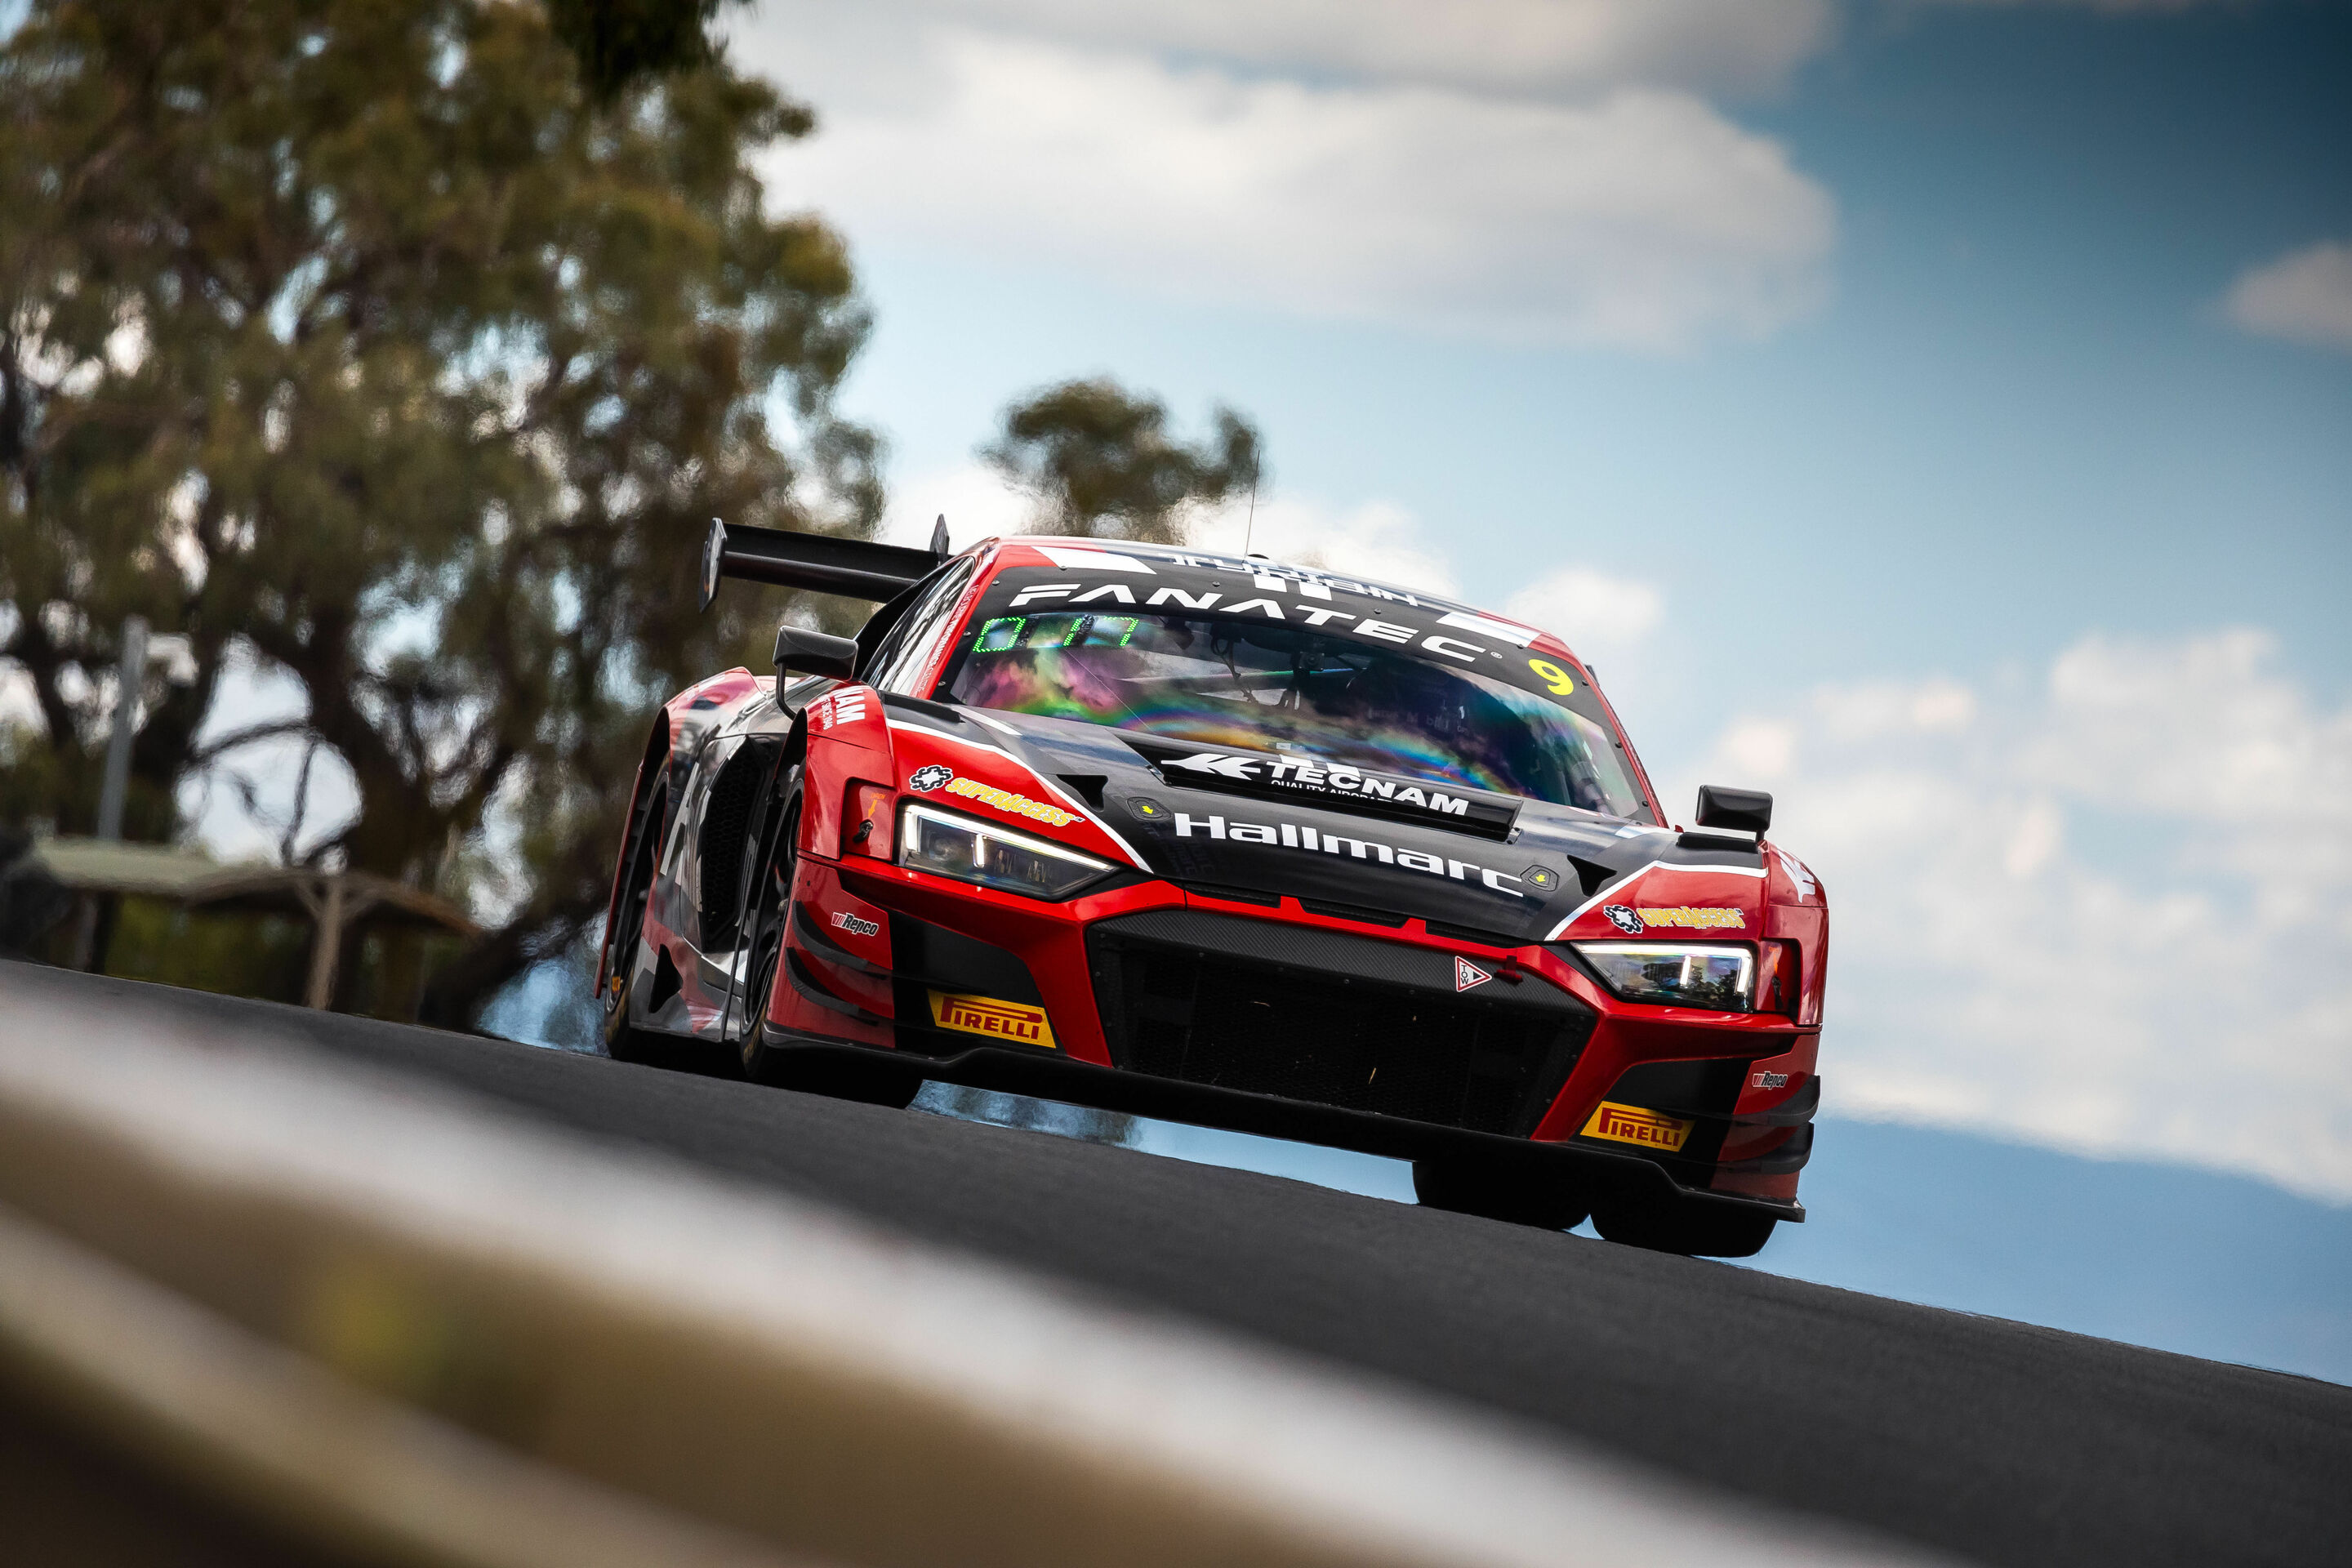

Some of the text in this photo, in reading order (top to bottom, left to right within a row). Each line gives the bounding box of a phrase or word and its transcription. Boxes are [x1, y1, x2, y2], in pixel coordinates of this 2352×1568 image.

[1008, 583, 1486, 662] FANATEC
[1528, 658, 1575, 696] 9
[1266, 760, 1468, 815] TECNAM
[1174, 812, 1525, 897] Hallmarc
[841, 912, 879, 936] Repco
[1460, 964, 1469, 985] TOW
[939, 996, 1043, 1040] PIRELLI
[1761, 1071, 1788, 1090] Repco
[1597, 1107, 1684, 1147] PIRELLI
